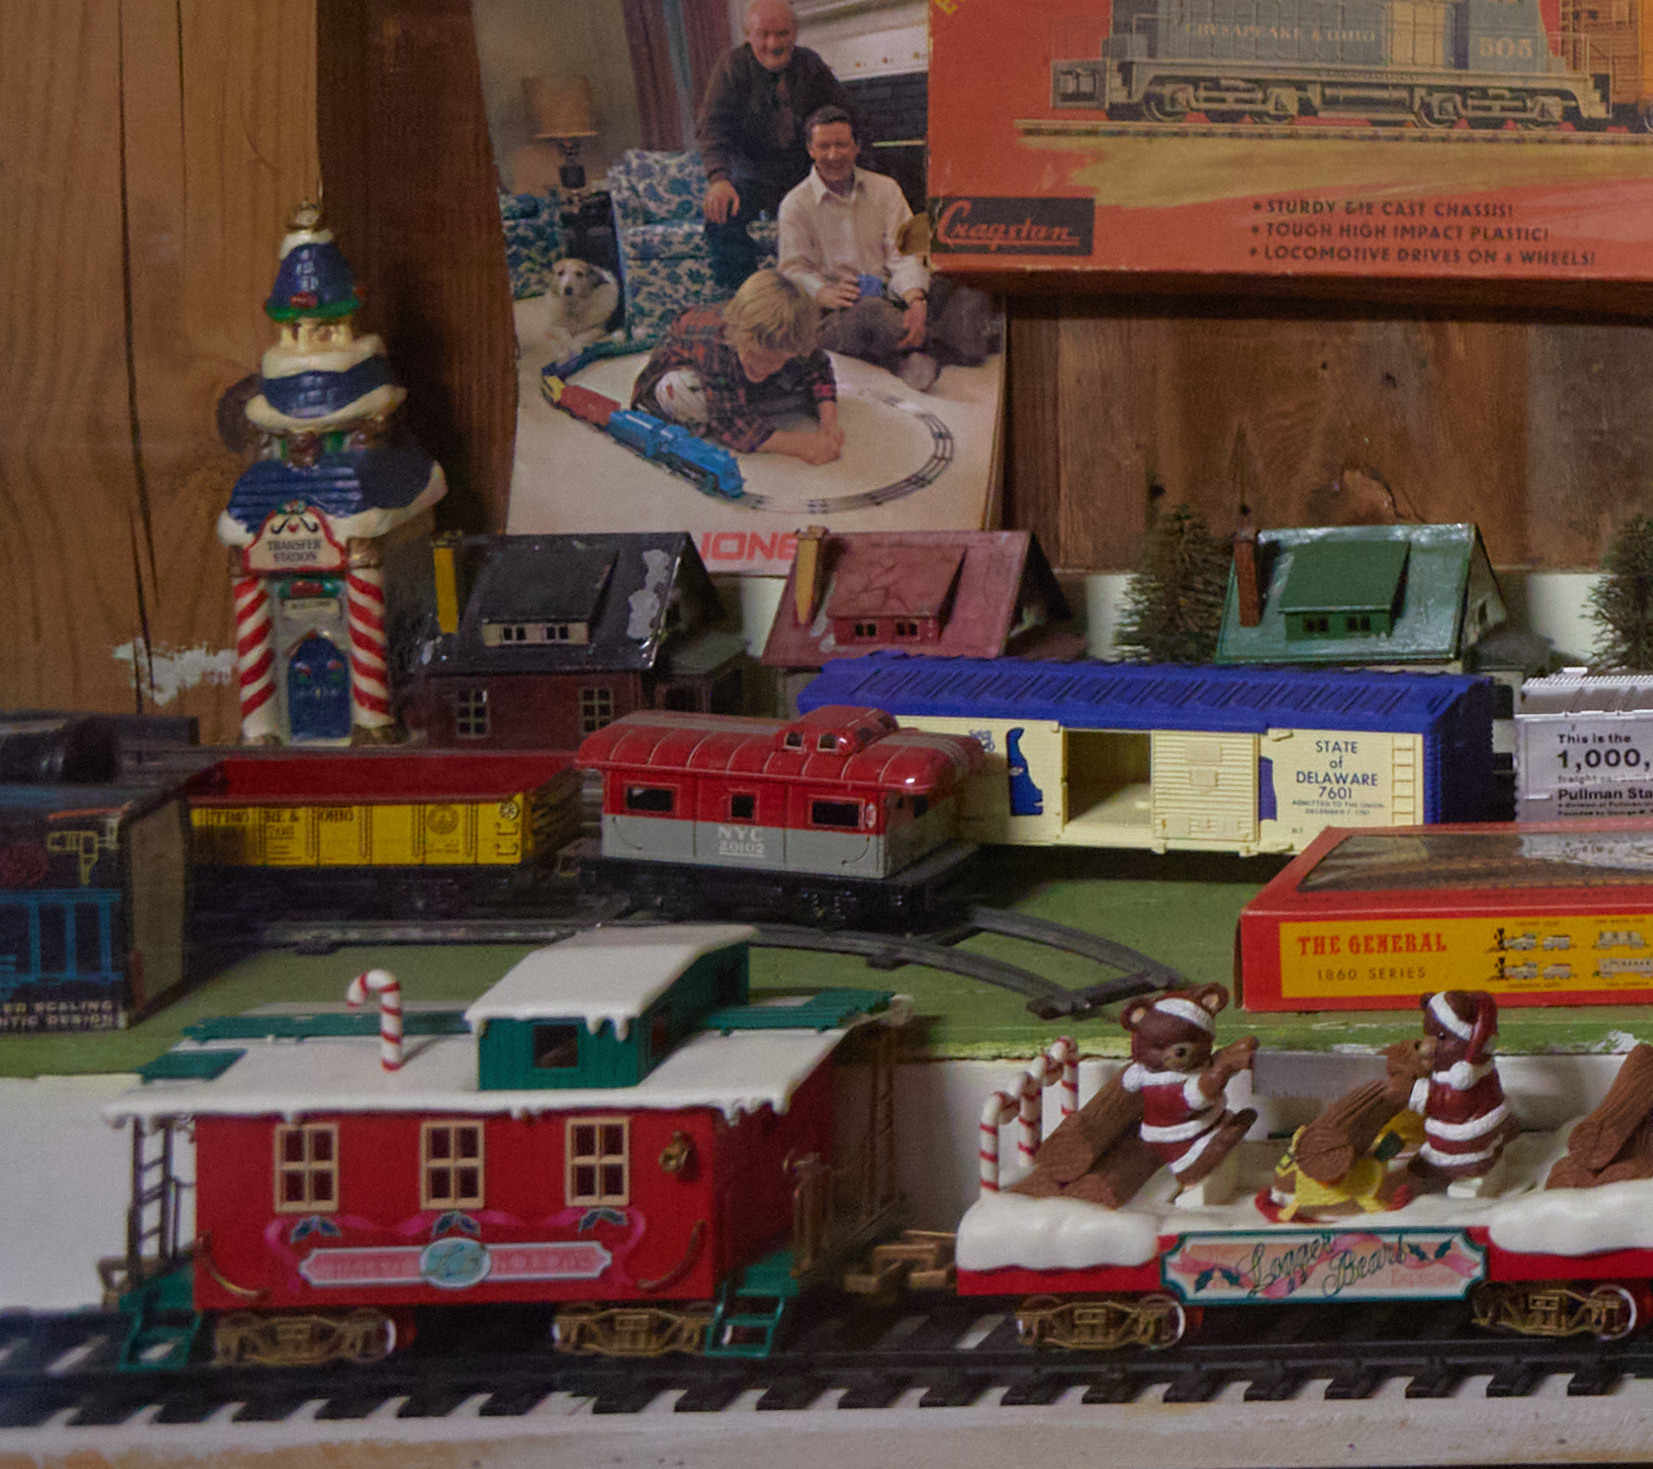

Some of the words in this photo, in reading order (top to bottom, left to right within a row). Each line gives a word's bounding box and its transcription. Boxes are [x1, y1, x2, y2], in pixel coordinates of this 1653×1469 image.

[1479, 37, 1534, 60] 505
[1266, 200, 1337, 214] STURDY
[1346, 201, 1374, 216] DIE
[1382, 202, 1426, 217] CAST
[1434, 204, 1514, 218] CHASSIS!
[934, 197, 1081, 251] Cragstan
[1265, 223, 1333, 238] TOUGH
[1339, 224, 1387, 239] HIGH
[1393, 225, 1465, 241] IMPACT
[1470, 226, 1550, 242] PLASTIC!
[1264, 245, 1391, 261] LOCOMOTIVE
[1398, 247, 1461, 263] DRIVES
[1467, 249, 1499, 263] ON
[1518, 250, 1597, 267] WHEELS!
[268, 539, 322, 551] TRANSFER
[273, 550, 317, 562] STATION
[1557, 733, 1588, 744] This
[1591, 733, 1602, 744] is
[1605, 733, 1632, 744] the
[1315, 740, 1358, 755] STATE
[1329, 755, 1343, 769] of
[1295, 770, 1378, 787] DELAWARE
[1318, 786, 1353, 800] 7601
[1557, 787, 1624, 800] Pullman
[718, 826, 763, 842] NYC
[1296, 934, 1341, 956] THE
[1348, 932, 1448, 955] GENERAL
[1316, 967, 1359, 982] 1860
[1368, 965, 1427, 980] SERIES
